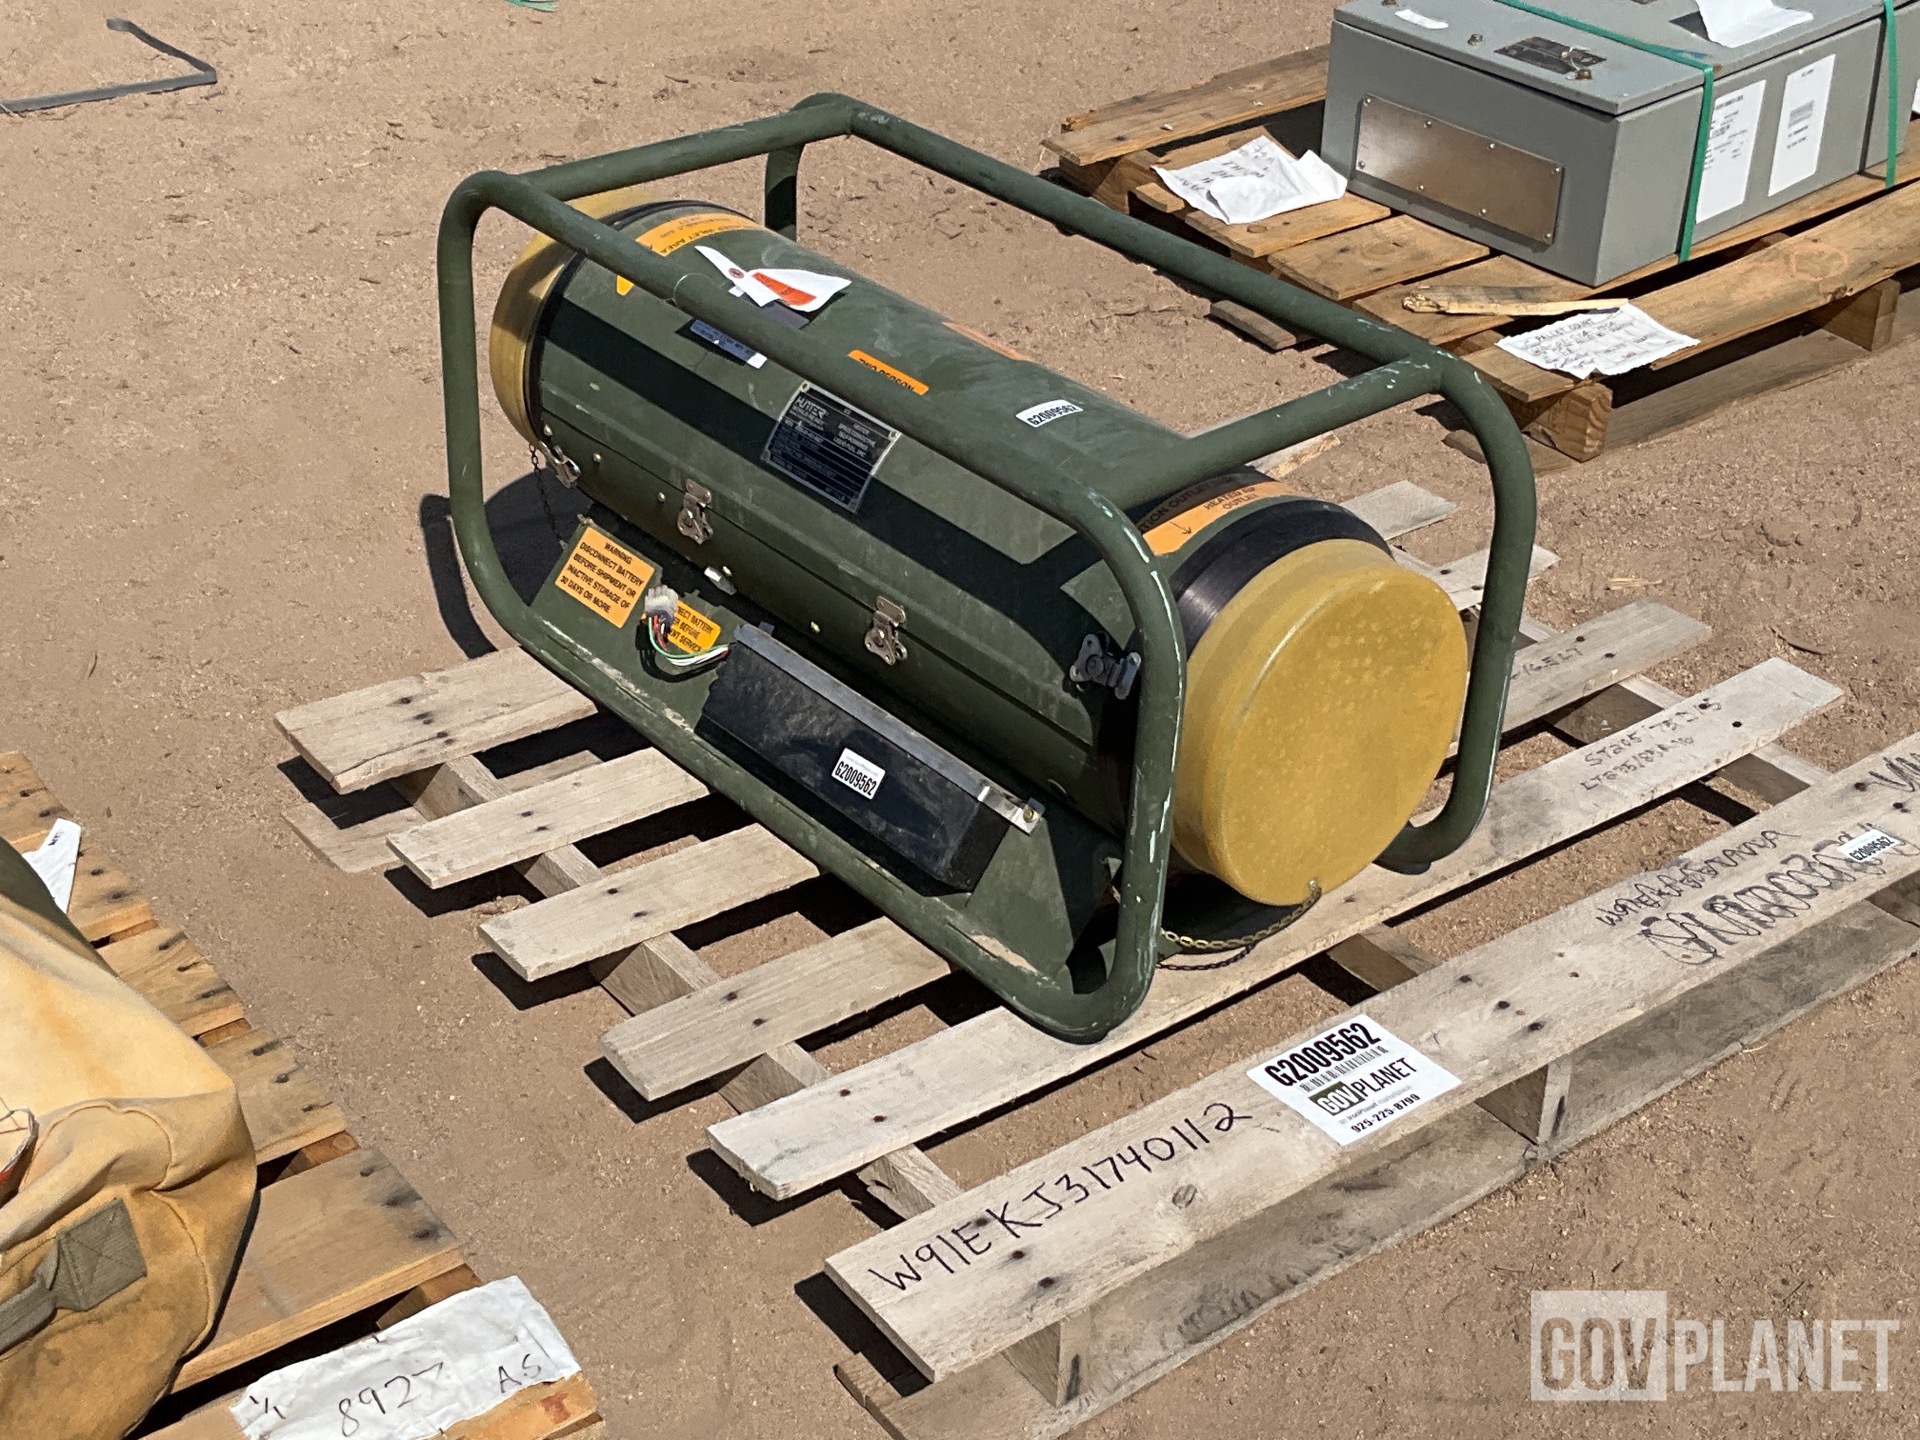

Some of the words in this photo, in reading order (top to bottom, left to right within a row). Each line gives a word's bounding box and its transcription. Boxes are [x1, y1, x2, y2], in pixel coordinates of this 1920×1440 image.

[573, 553, 598, 572] BEFORE
[596, 568, 627, 592] SHIPMENT
[626, 587, 637, 598] OR
[579, 542, 617, 570] DISCONNECT
[616, 565, 644, 587] BATTERY
[604, 542, 632, 565] WARNING
[567, 564, 594, 585] INACTIVE
[593, 581, 620, 604] STORAGE
[620, 600, 631, 609] OF
[567, 579, 584, 596] DAYS
[592, 595, 611, 613] MORE
[835, 760, 877, 796] G2009562
[1264, 1022, 1382, 1087] G2009562
[1351, 1093, 1421, 1133] 925-225-8799
[338, 1362, 444, 1437] 8927
